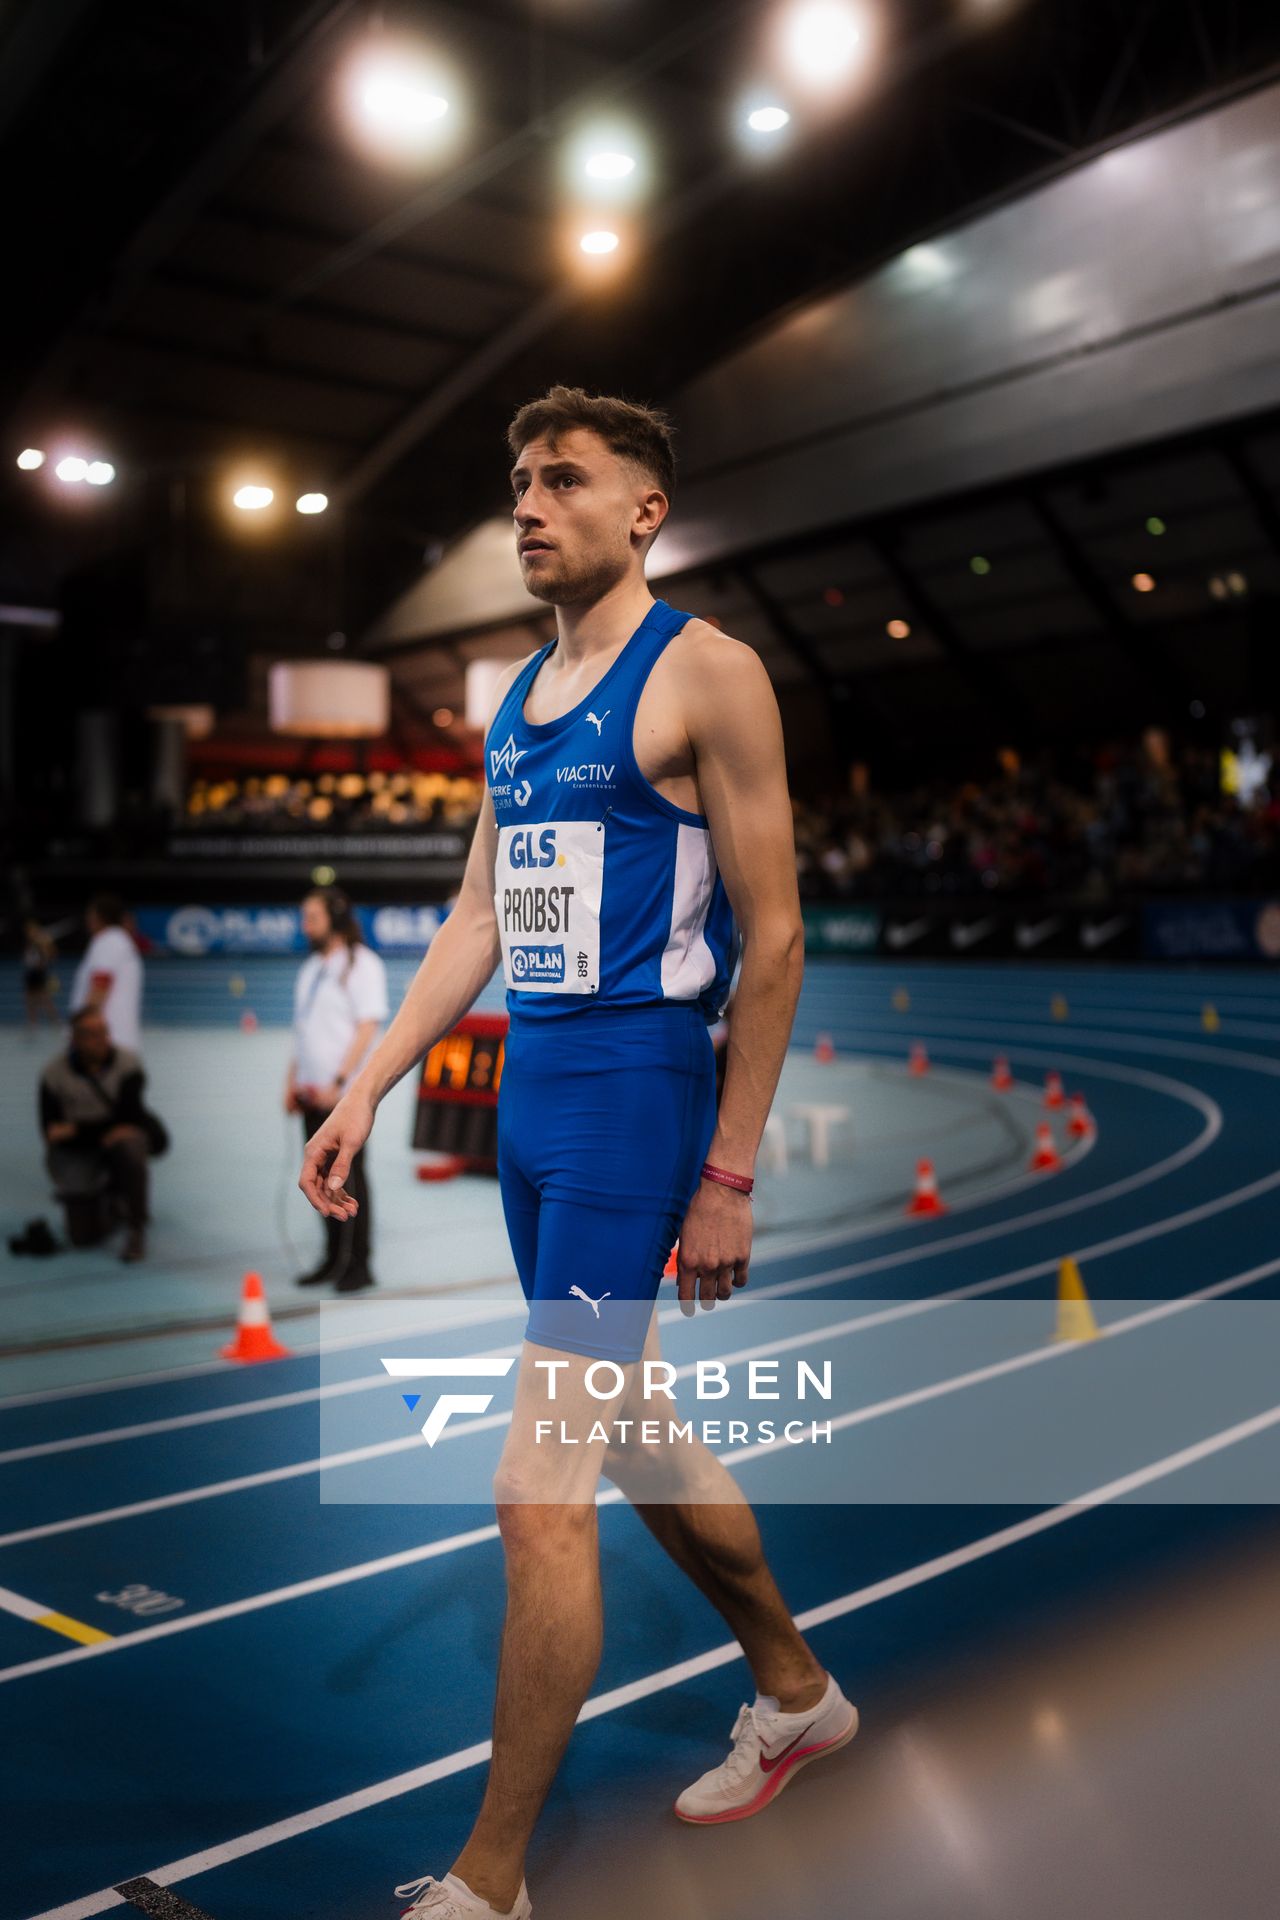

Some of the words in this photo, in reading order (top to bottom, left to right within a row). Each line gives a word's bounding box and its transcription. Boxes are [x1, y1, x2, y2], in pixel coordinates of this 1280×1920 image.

[556, 764, 615, 783] VIACTIV
[504, 886, 575, 933] PROBST
[529, 952, 563, 969] PLAN
[577, 951, 589, 978] 468
[529, 971, 562, 979] INTERNATIONAL
